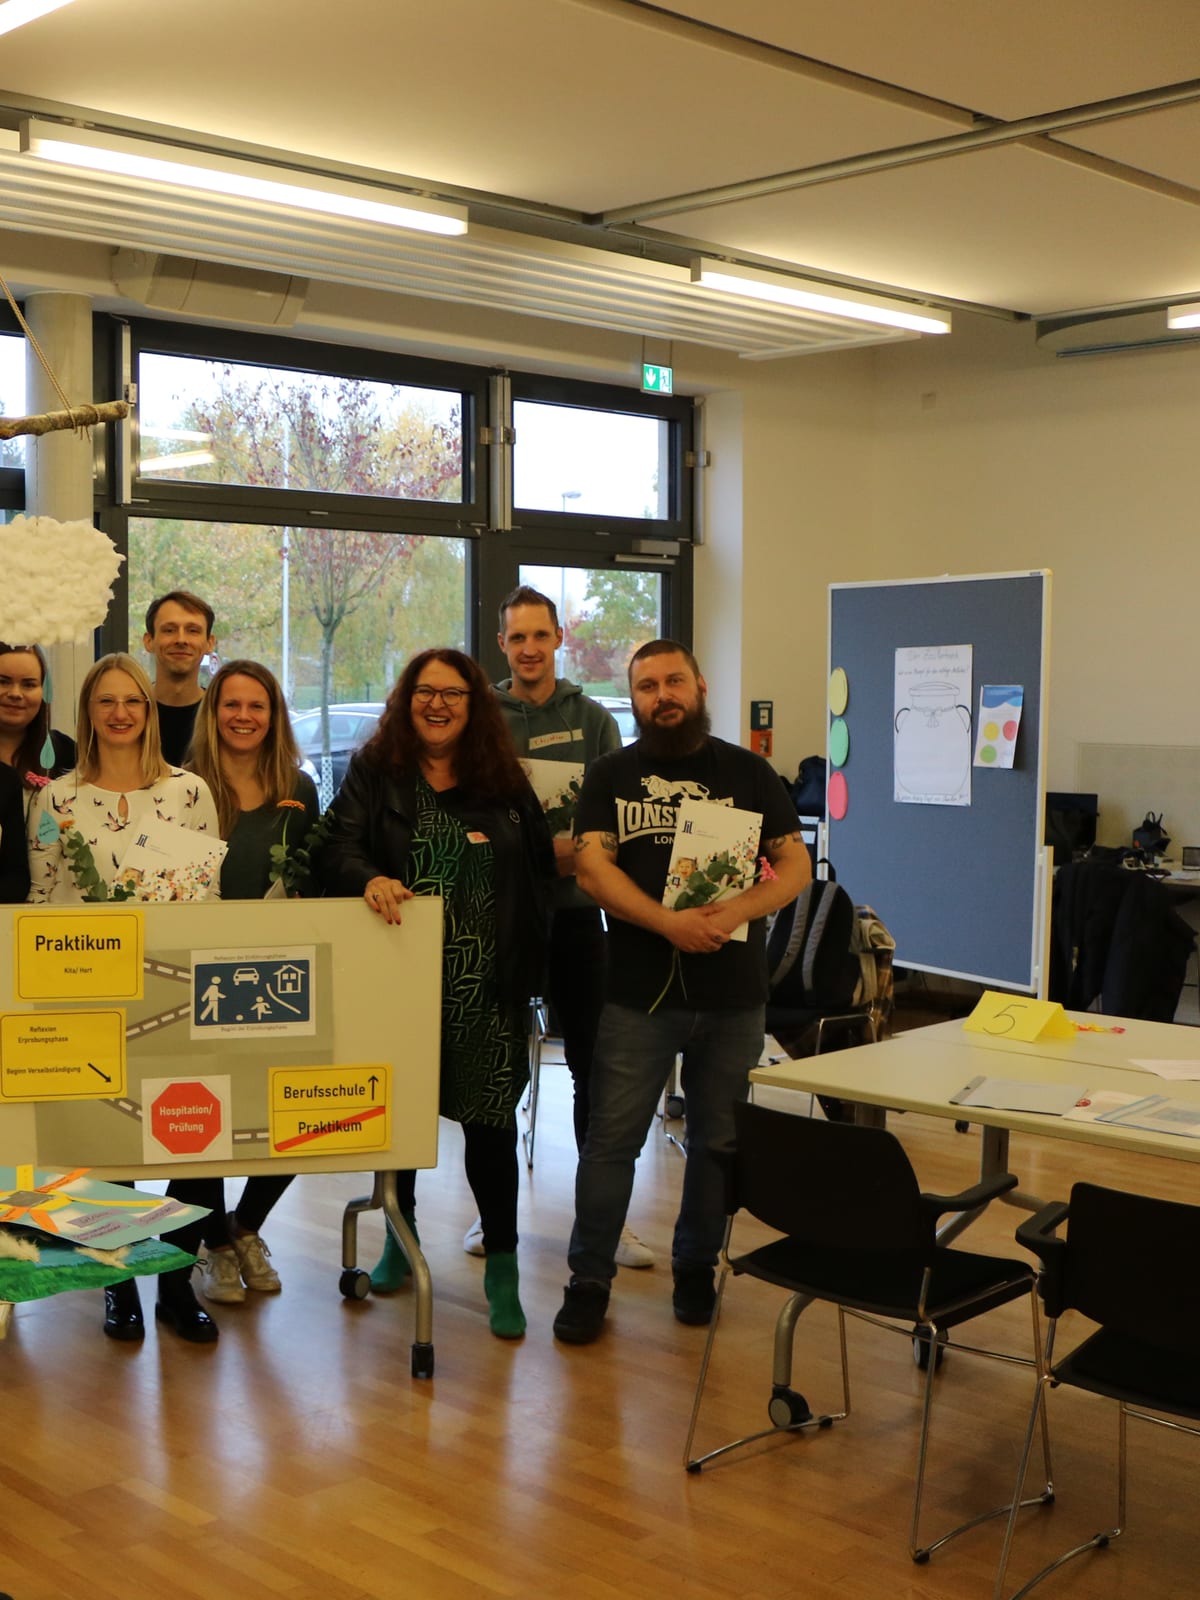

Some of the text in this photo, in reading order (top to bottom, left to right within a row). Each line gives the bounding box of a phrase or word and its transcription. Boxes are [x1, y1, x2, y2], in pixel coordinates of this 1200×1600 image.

[35, 934, 121, 951] Praktikum
[983, 1004, 1028, 1035] 5
[18, 1036, 69, 1044] Erprobungsphase
[6, 1067, 27, 1075] Beginn
[283, 1083, 366, 1099] Berufsschule
[159, 1103, 213, 1118] Hospitation/
[169, 1121, 204, 1133] Prüfung
[298, 1119, 362, 1135] Praktikum
